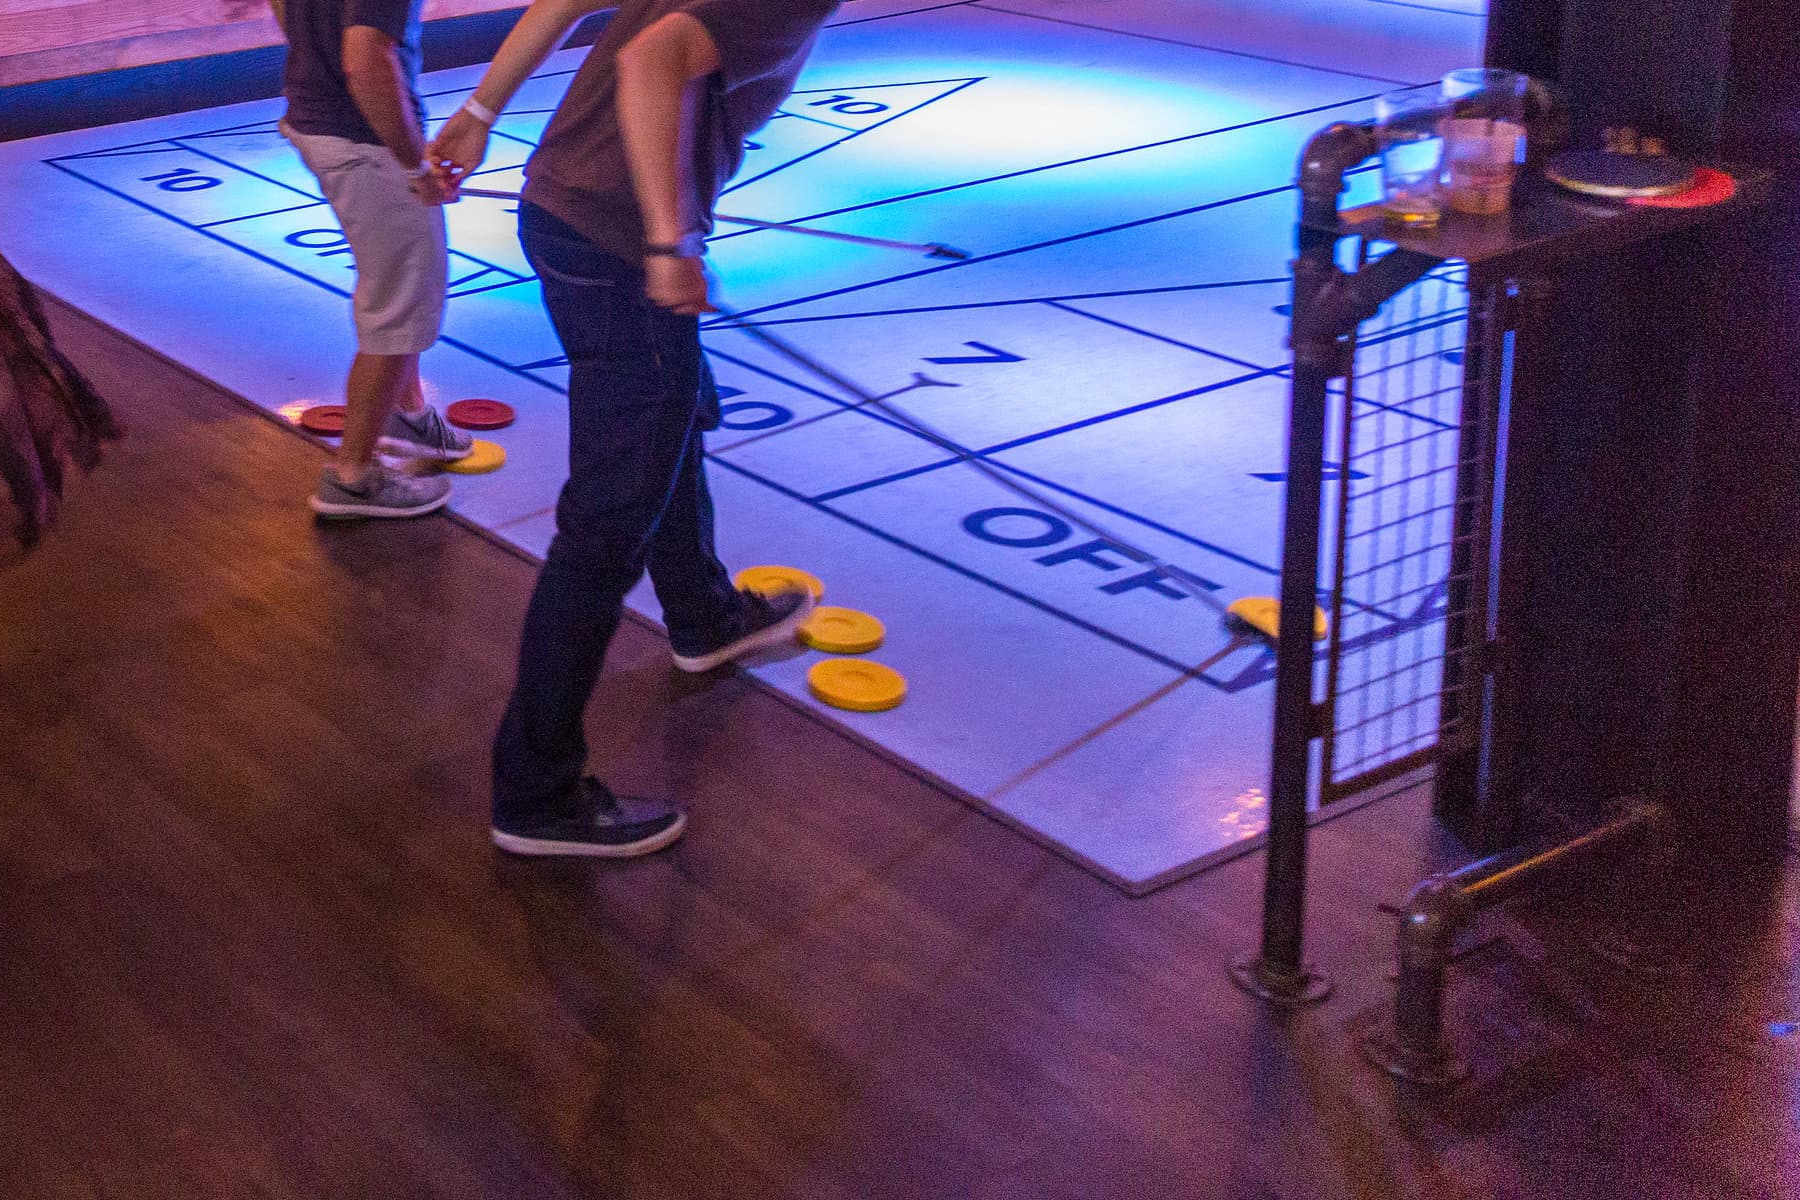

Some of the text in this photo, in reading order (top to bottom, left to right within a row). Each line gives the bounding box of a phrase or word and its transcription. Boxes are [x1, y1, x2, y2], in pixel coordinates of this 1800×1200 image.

[805, 95, 891, 115] 10
[137, 167, 223, 192] 10
[919, 340, 1029, 365] 7
[961, 506, 1225, 600] OFF
